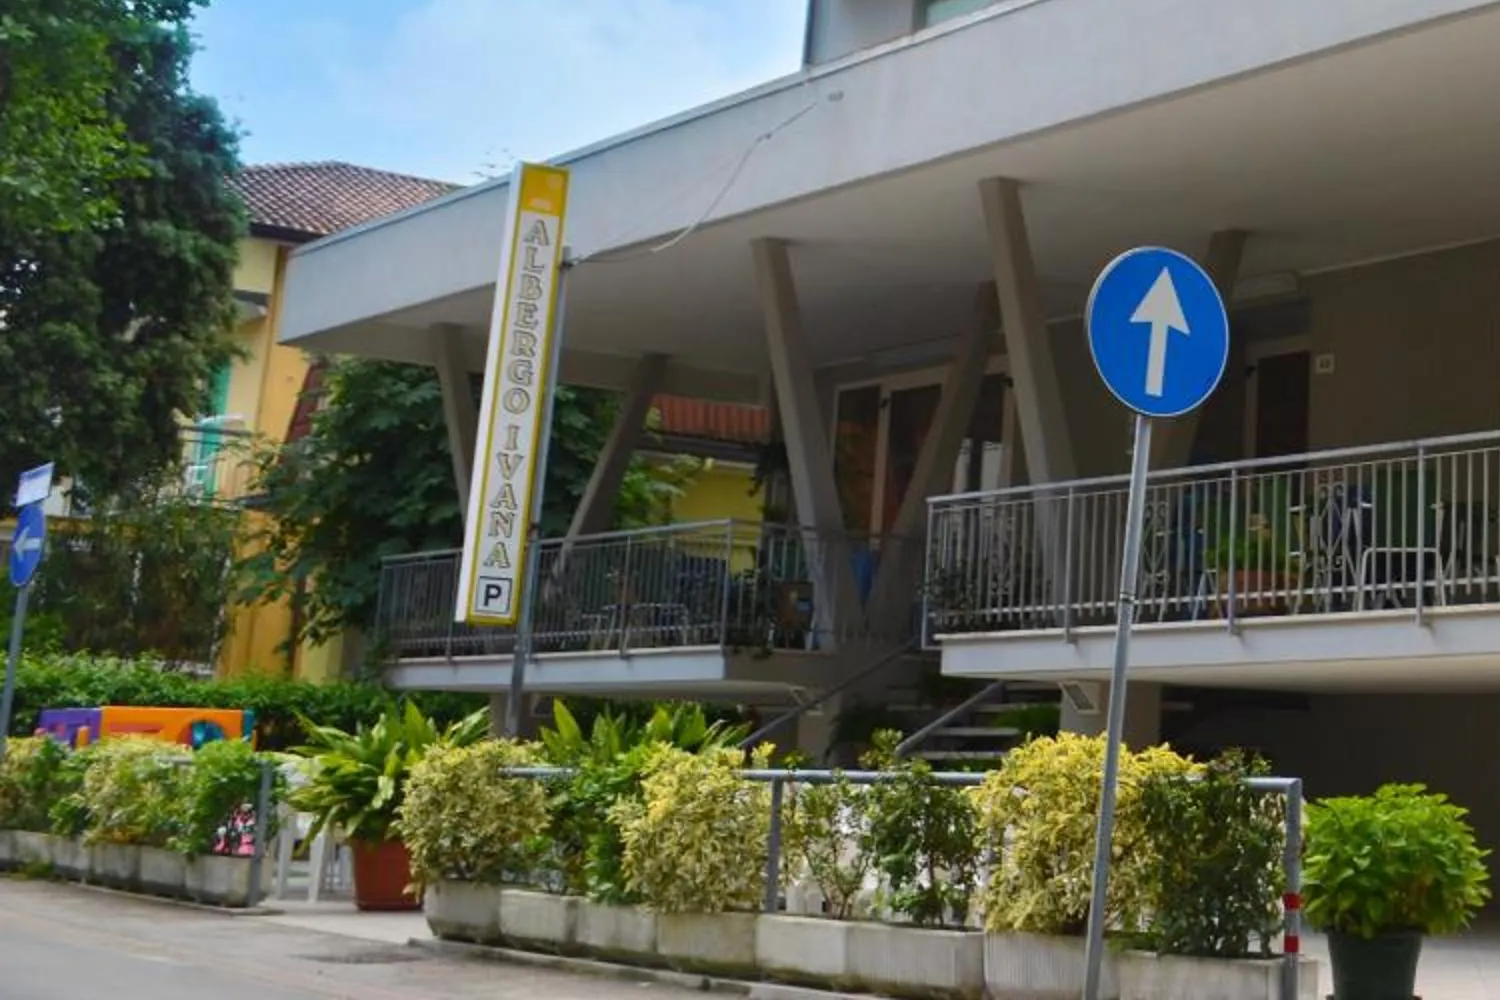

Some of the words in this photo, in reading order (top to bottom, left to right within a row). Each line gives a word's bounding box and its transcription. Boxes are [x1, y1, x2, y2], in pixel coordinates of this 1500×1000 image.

[503, 219, 549, 414] ALBERGO
[483, 425, 523, 568] IVANA
[483, 583, 502, 607] P
